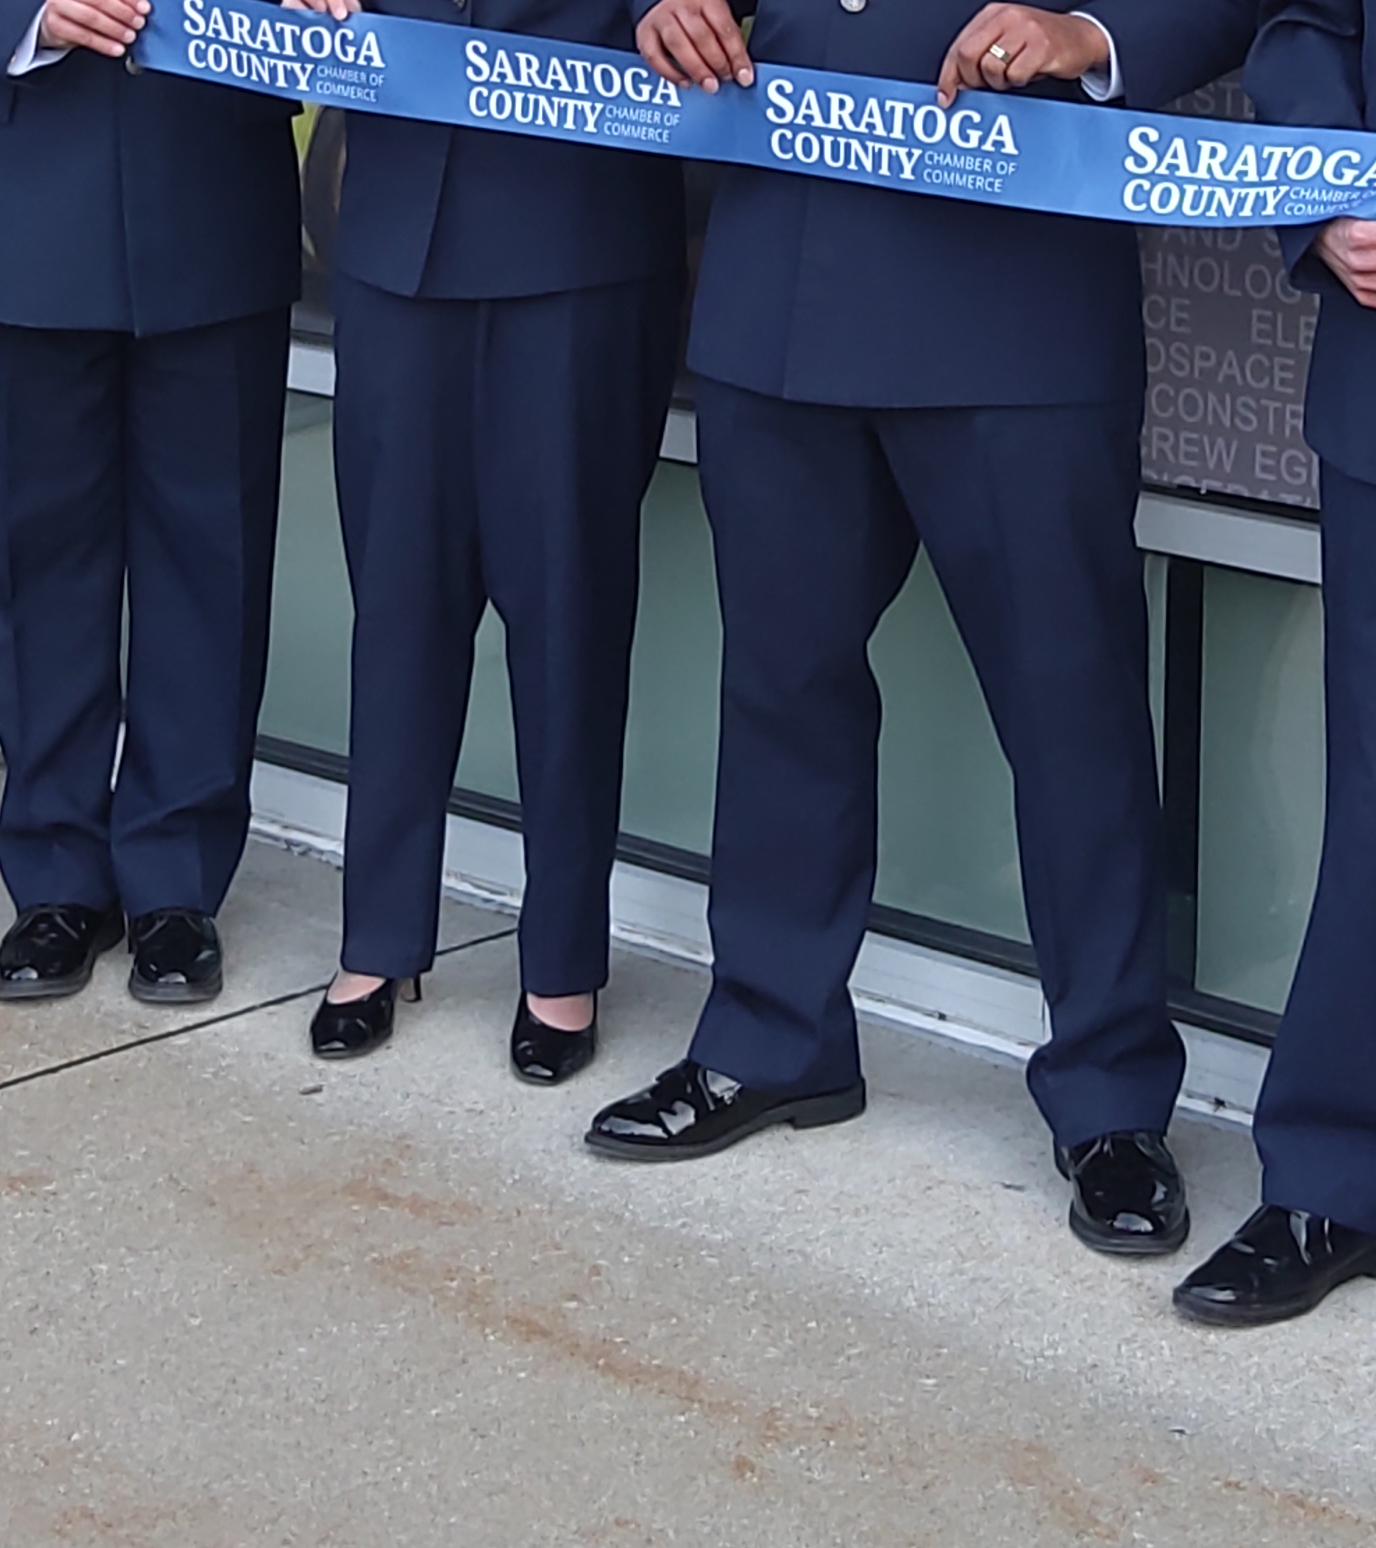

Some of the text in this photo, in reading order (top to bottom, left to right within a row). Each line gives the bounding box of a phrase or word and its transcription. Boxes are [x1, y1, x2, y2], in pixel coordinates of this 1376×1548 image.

[188, 39, 315, 92] COUNTY
[317, 65, 384, 87] CHAMBER OF
[465, 40, 682, 107] SARATOGA
[316, 81, 377, 102] COMMERCE
[469, 86, 604, 133] COUNTY
[605, 105, 680, 126] CHAMBER OF
[766, 79, 1019, 155] SARATOGA
[603, 122, 670, 143] COMMERCE
[771, 129, 923, 180] COUNTY
[925, 151, 1018, 176] CHAMBER OF
[924, 169, 1003, 193] COMMERCE
[1123, 178, 1289, 217] COUNTY
